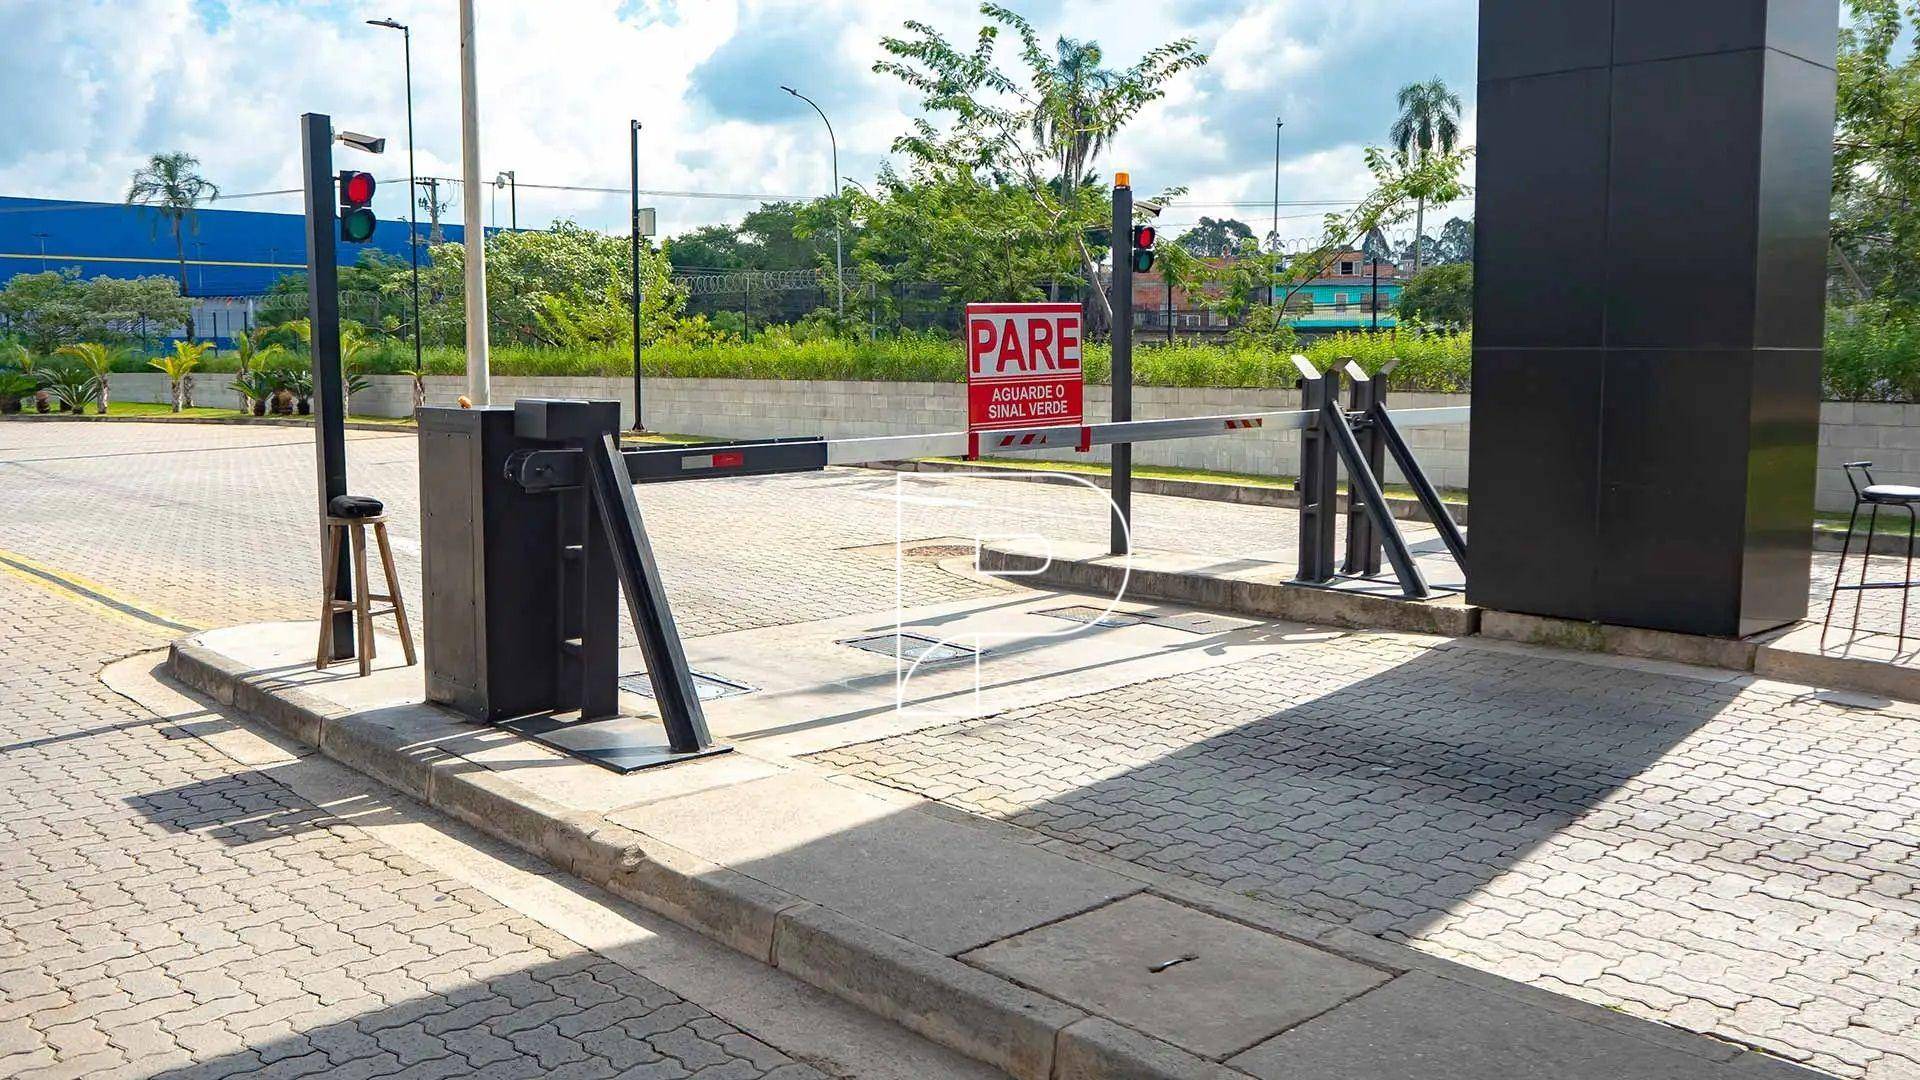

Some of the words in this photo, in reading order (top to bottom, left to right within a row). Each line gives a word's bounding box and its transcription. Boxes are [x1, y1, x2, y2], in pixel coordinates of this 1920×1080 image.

[971, 318, 1080, 373] PARE
[992, 385, 1053, 402] AGUARDE
[1056, 384, 1065, 398] O
[988, 403, 1026, 419] SINAL
[1029, 400, 1068, 416] VERDE
